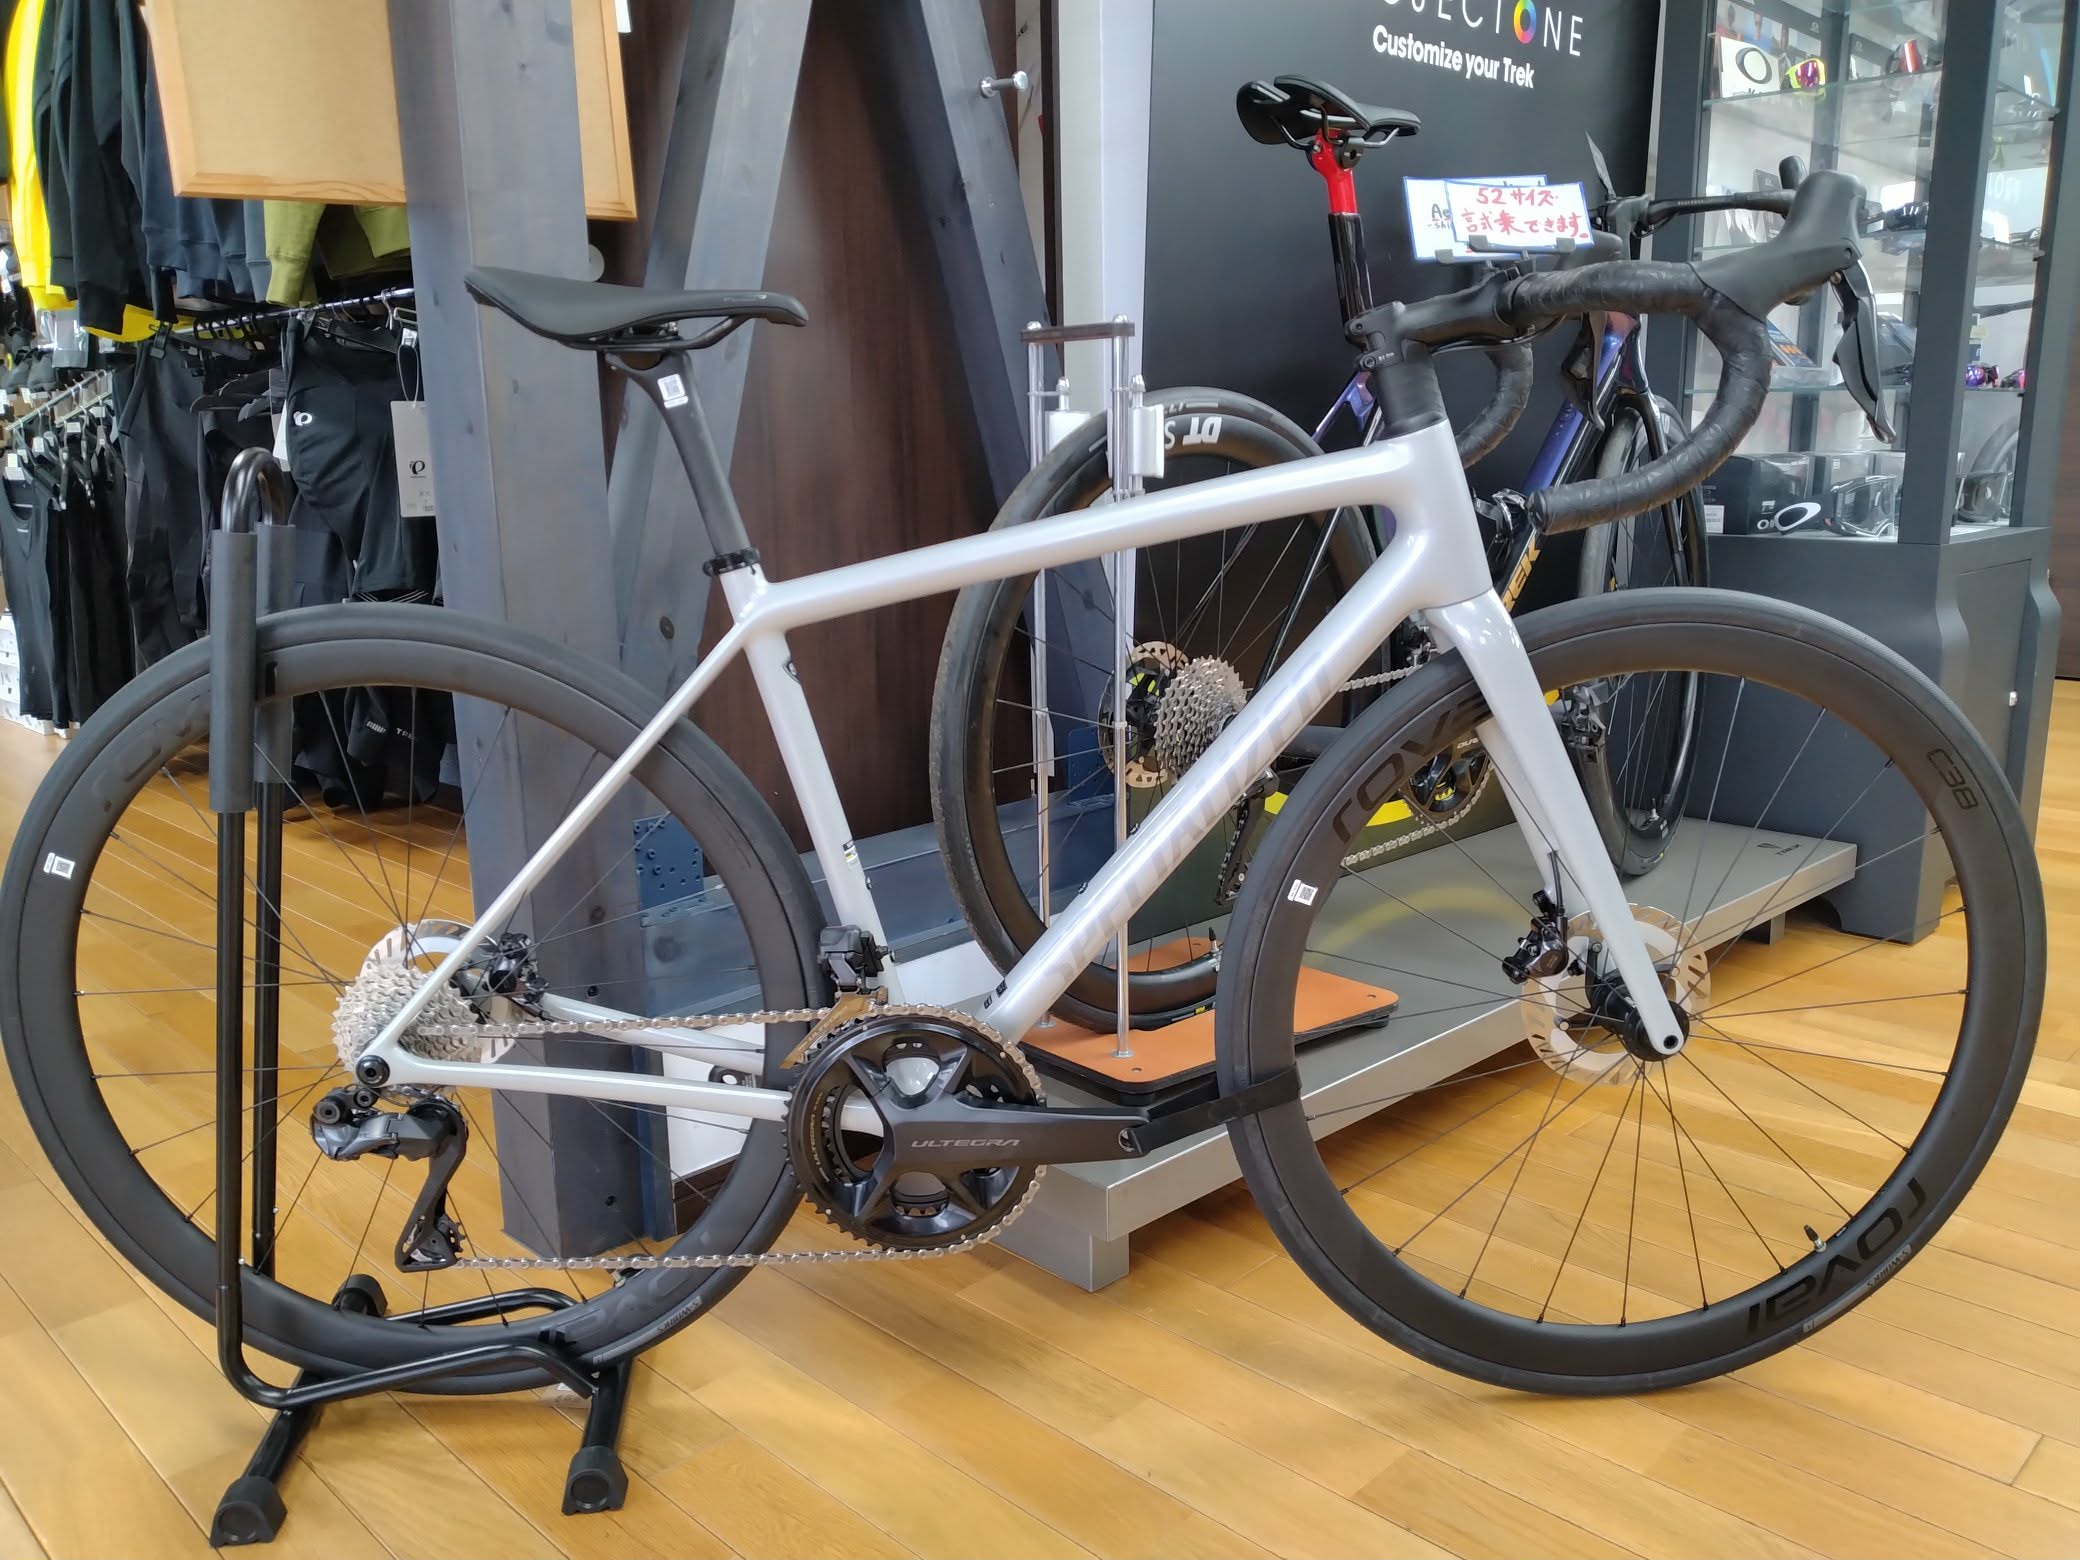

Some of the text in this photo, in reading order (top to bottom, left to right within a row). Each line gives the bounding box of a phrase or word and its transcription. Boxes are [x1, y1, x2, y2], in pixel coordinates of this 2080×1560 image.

[1372, 24, 1536, 88] Customize your Trek
[1182, 416, 1222, 446] DT
[911, 1138, 1020, 1149] ULTEGRA
